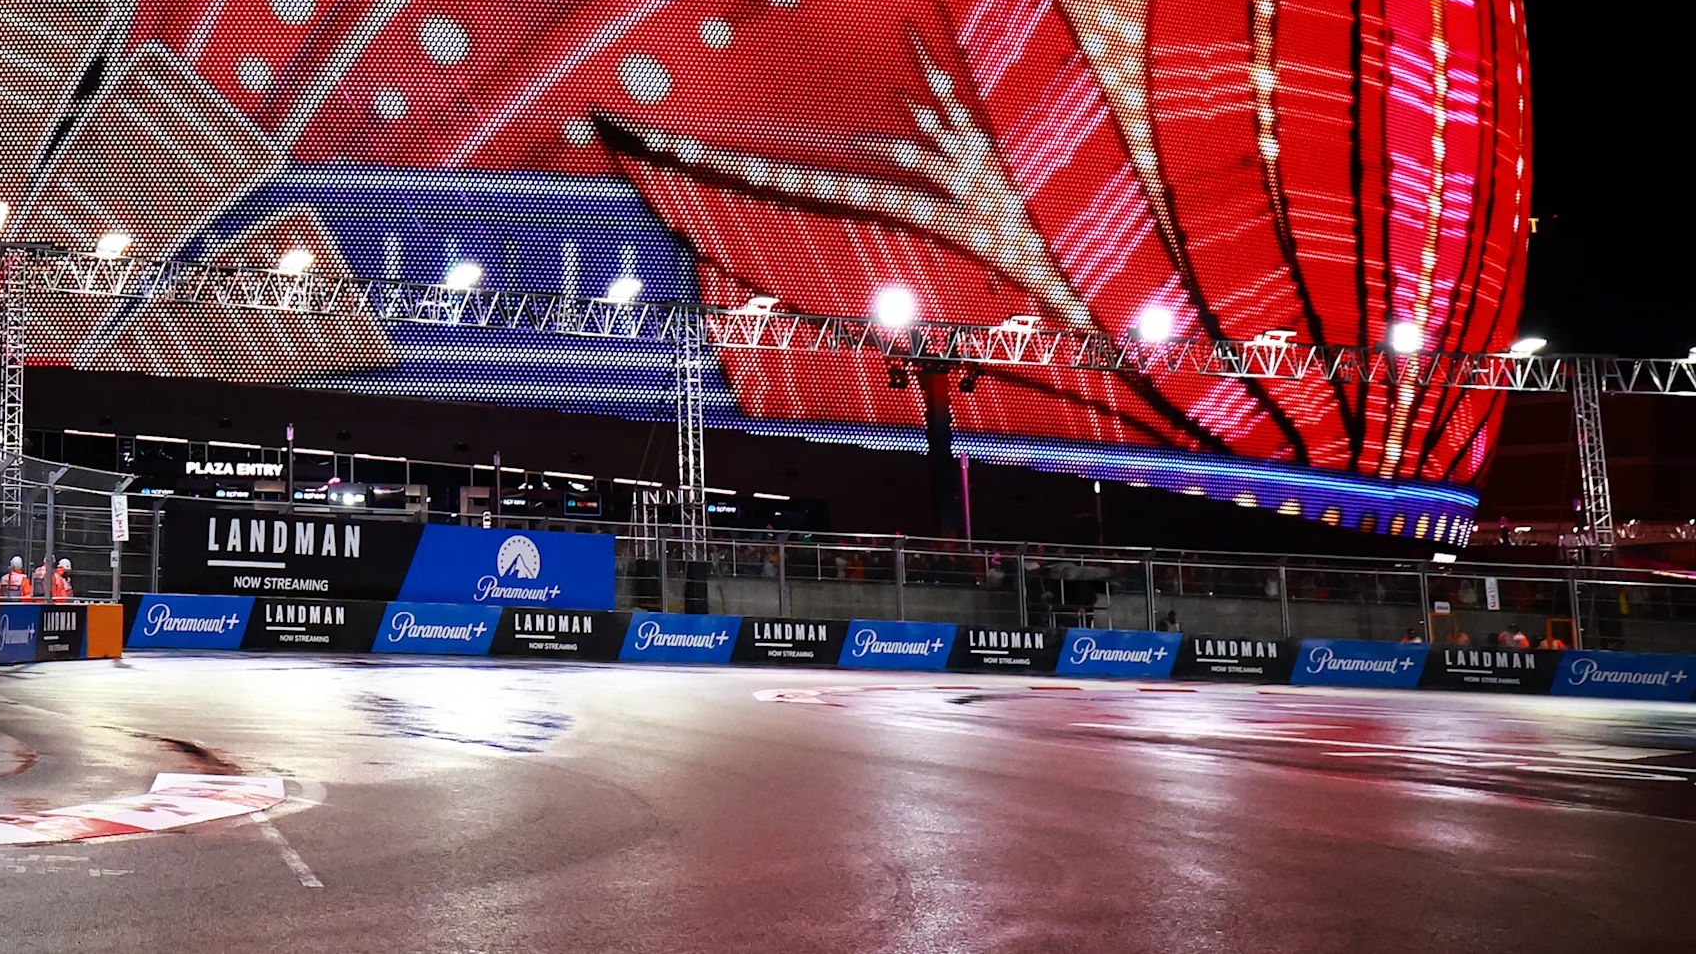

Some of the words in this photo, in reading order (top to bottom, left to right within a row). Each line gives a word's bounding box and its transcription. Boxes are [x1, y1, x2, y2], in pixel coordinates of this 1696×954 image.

[186, 462, 234, 475] PLAZA
[236, 463, 284, 476] ENTRY
[207, 517, 361, 559] LANDMAN
[233, 576, 261, 589] NOW
[263, 577, 329, 592] STREAMING
[473, 575, 561, 603] Paramount+
[146, 603, 240, 636] Paramount+
[265, 604, 345, 625] LANDMAN
[514, 613, 592, 634] LANDMAN
[279, 634, 294, 642] NOW
[295, 635, 330, 643] STREAMING
[388, 612, 487, 642] Paramount+
[635, 621, 729, 651] Paramount+
[754, 622, 827, 642] LANDMAN
[853, 629, 944, 657] Paramount+
[969, 630, 1044, 650] LANDMAN
[1071, 637, 1168, 665] Paramount+
[1194, 639, 1277, 658] LANDMAN
[1306, 646, 1415, 674] Paramount+
[1444, 650, 1536, 670] LANDMAN
[1568, 657, 1688, 687] Paramount+
